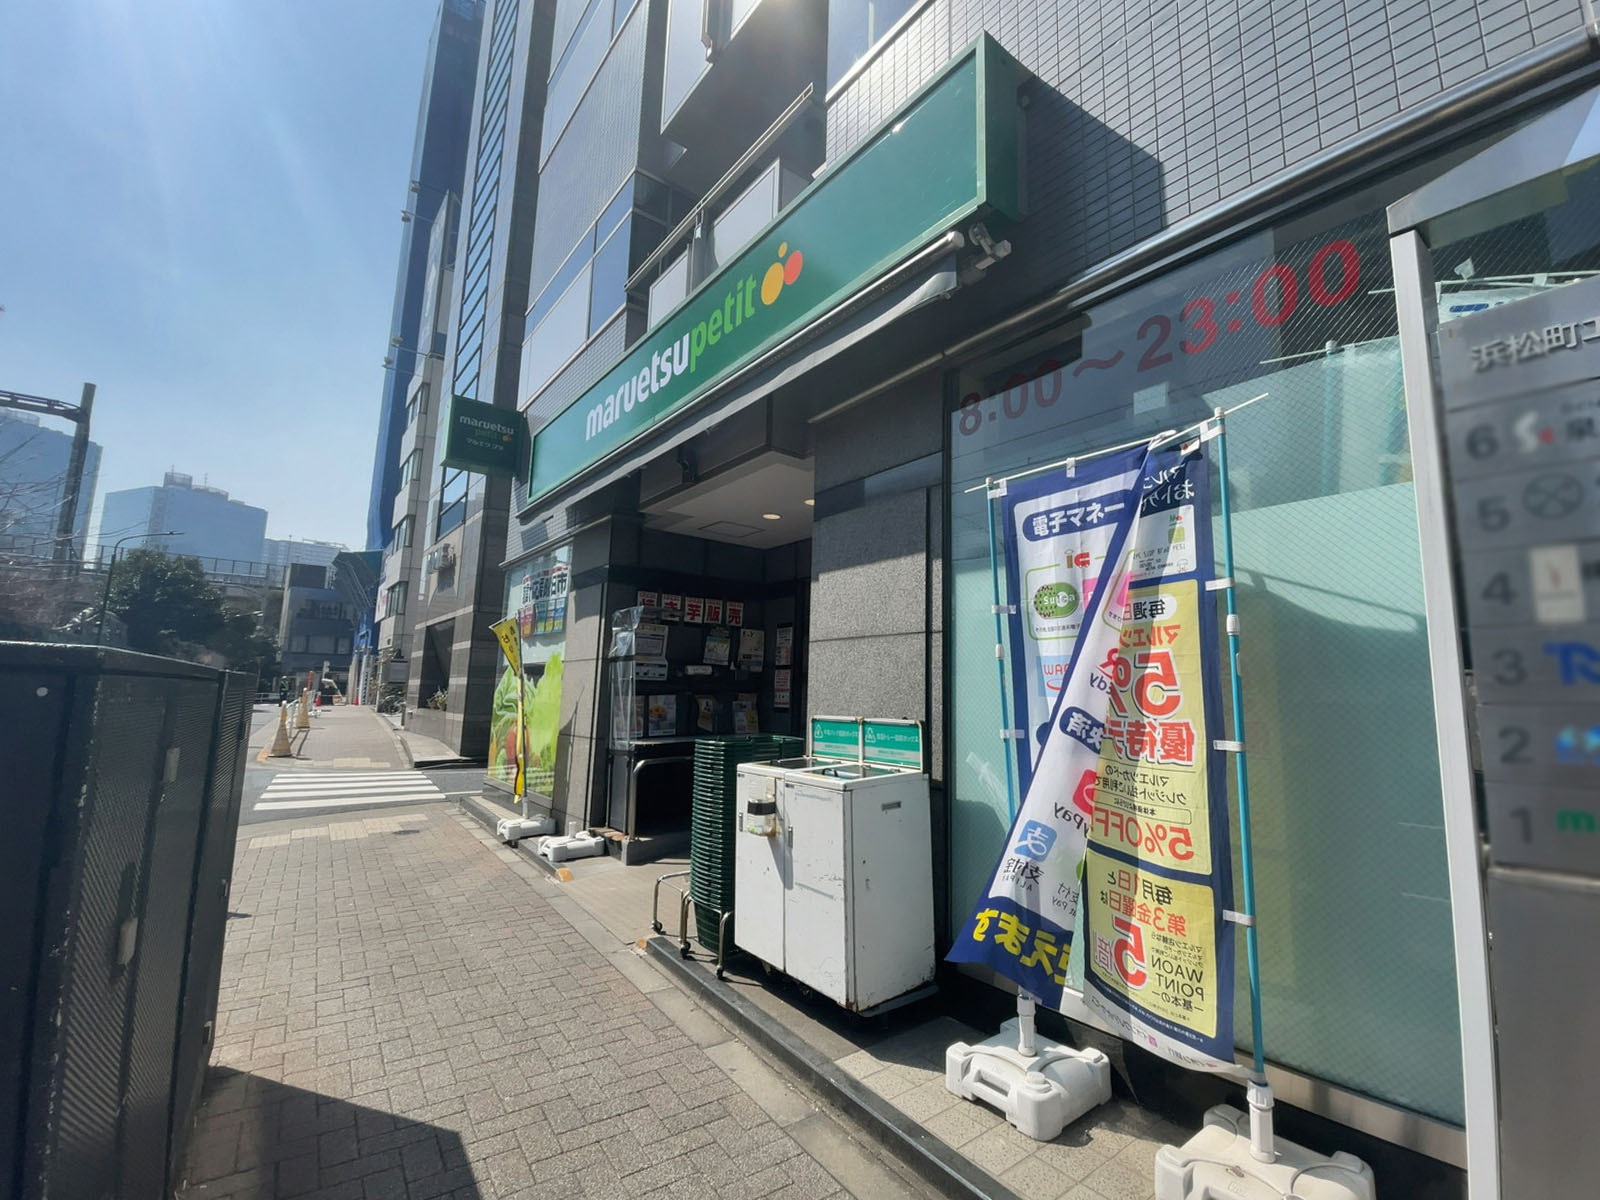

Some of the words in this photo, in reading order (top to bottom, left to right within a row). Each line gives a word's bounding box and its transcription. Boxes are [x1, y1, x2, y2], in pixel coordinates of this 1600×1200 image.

[460, 415, 515, 435] maruetsu
[1465, 424, 1499, 460] 6
[1032, 501, 1125, 537] 電子マネー
[1477, 496, 1510, 533] 5
[1481, 571, 1517, 606] 4
[1490, 647, 1528, 686] 3
[1498, 725, 1533, 765] 2
[1509, 807, 1533, 844] 1
